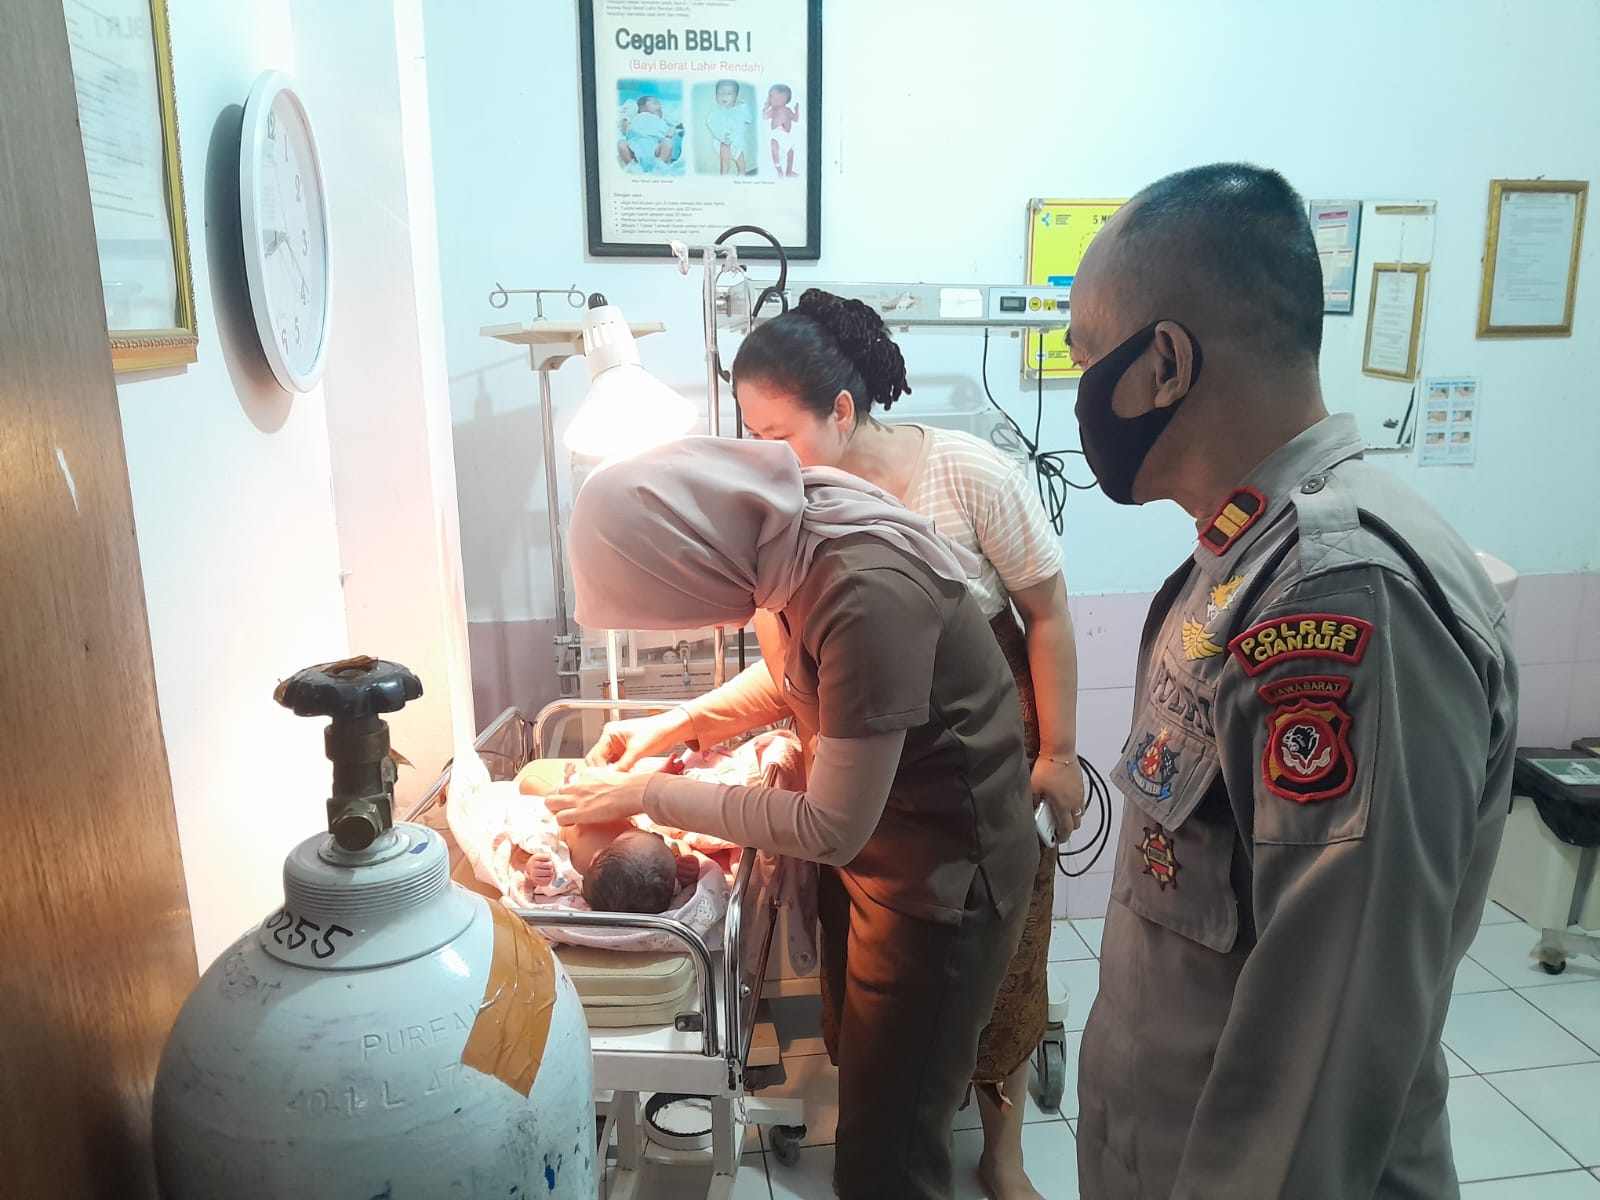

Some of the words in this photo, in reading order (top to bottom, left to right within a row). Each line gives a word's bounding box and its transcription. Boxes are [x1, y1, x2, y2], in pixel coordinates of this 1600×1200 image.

[615, 27, 679, 55] Cegah
[685, 29, 740, 53] BBLR
[629, 59, 656, 72] (Bayi
[659, 60, 688, 71] Berat
[690, 61, 717, 71] Lahir
[719, 61, 764, 73] Rendah)
[294, 174, 301, 203] 2
[1092, 214, 1099, 225] 5
[302, 228, 310, 257] 3
[300, 277, 311, 306] 4
[294, 316, 301, 346] 5
[1240, 620, 1359, 655] POLRES
[1253, 633, 1347, 662] CIANJUR
[1303, 681, 1341, 692] BARAT
